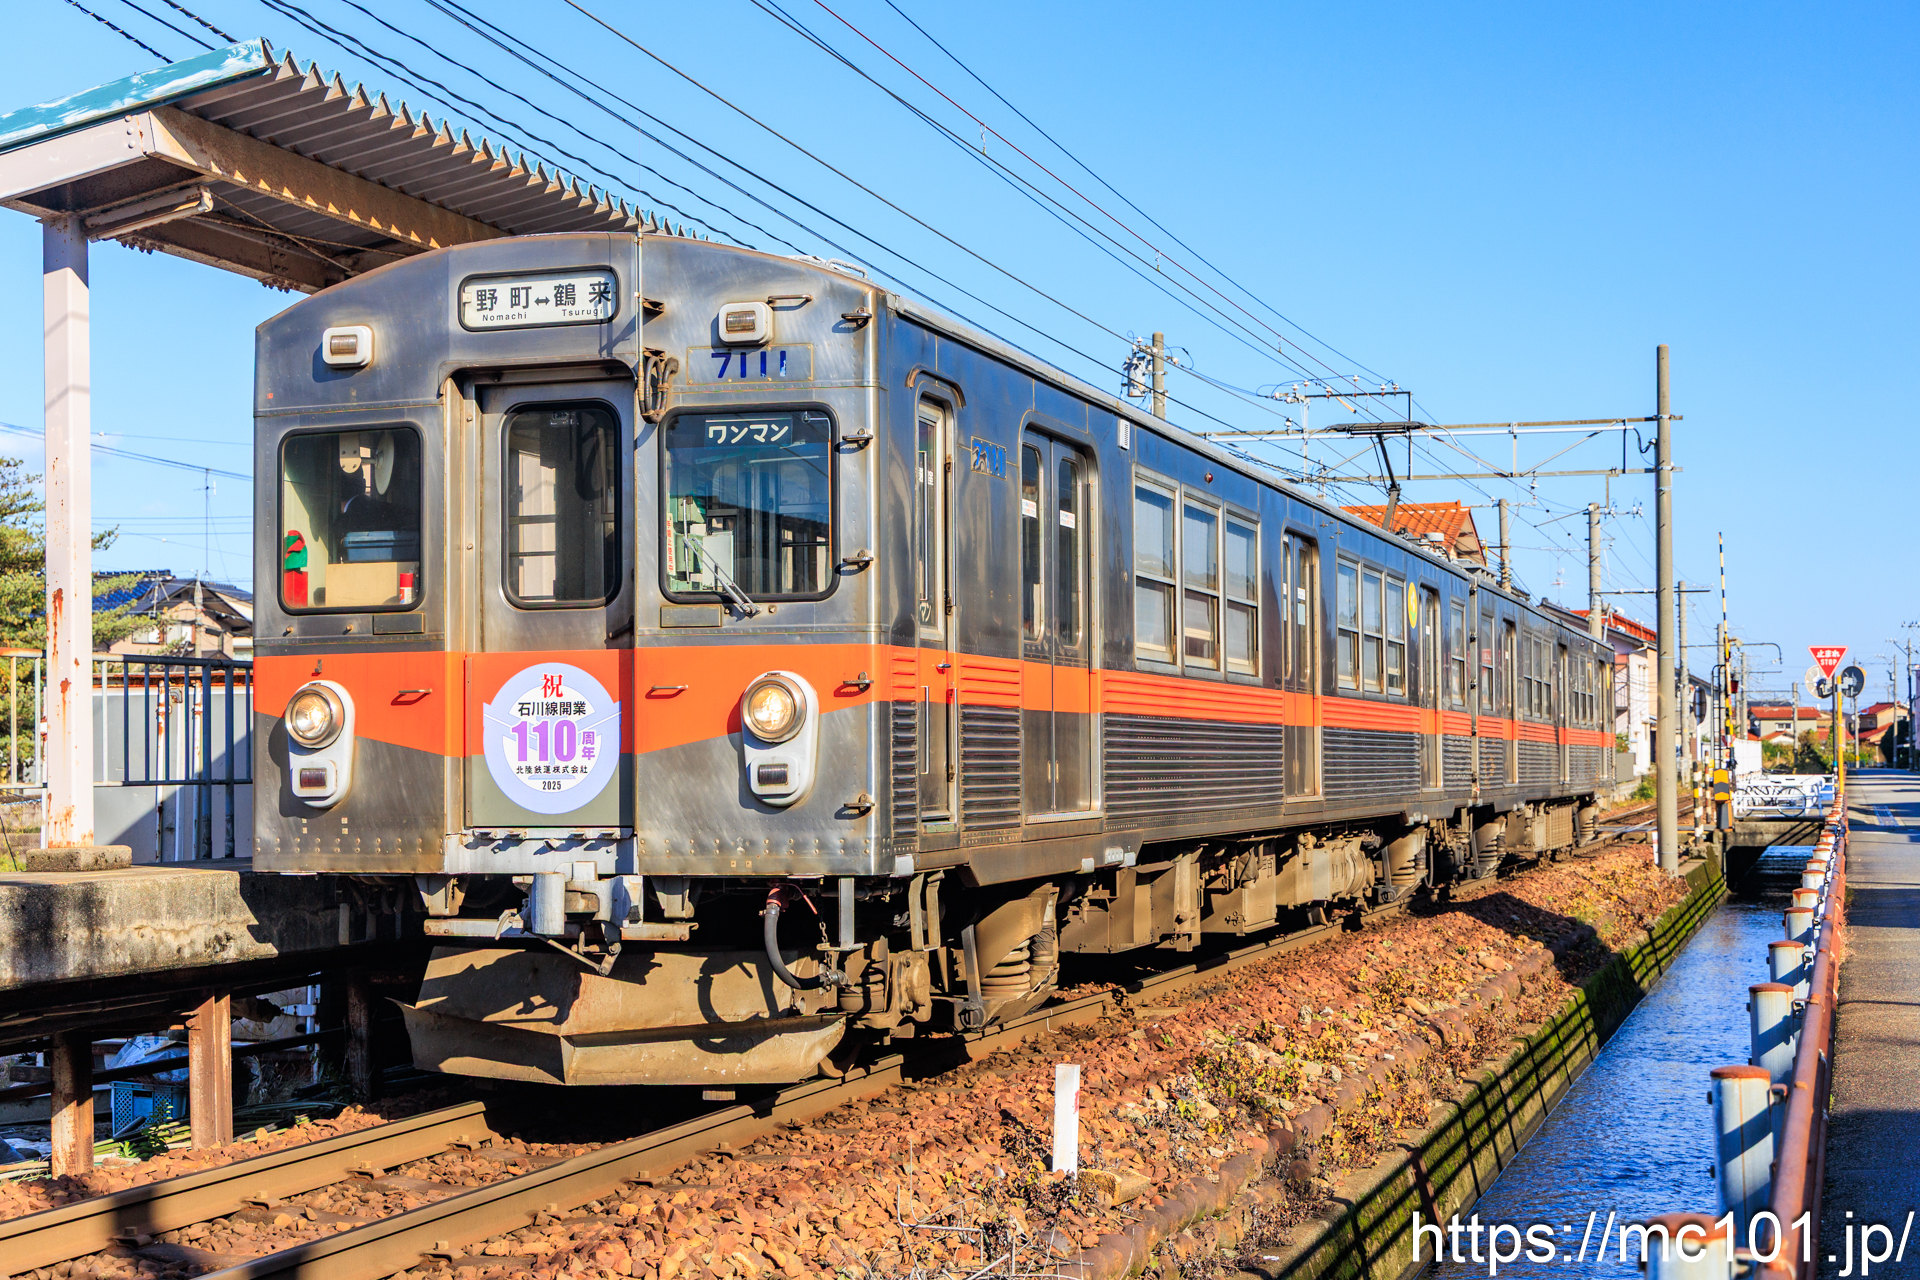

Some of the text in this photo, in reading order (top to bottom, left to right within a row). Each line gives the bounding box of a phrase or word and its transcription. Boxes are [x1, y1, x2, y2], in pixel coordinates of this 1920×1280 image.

[476, 281, 611, 312] 野町 鶴来
[482, 307, 603, 321] Nomachi Tsurugi
[711, 350, 787, 378] 7111
[708, 424, 789, 444] ワンマン
[974, 442, 1003, 473] 7111
[1816, 649, 1841, 658] 止まれ
[1820, 658, 1838, 666] STOP
[540, 673, 564, 698] 祝
[518, 701, 586, 716] 石川線開業
[511, 719, 577, 762] 110
[581, 731, 596, 760] 周年
[516, 765, 588, 774] 北陸鉄道株式会社
[542, 780, 562, 790] 2025
